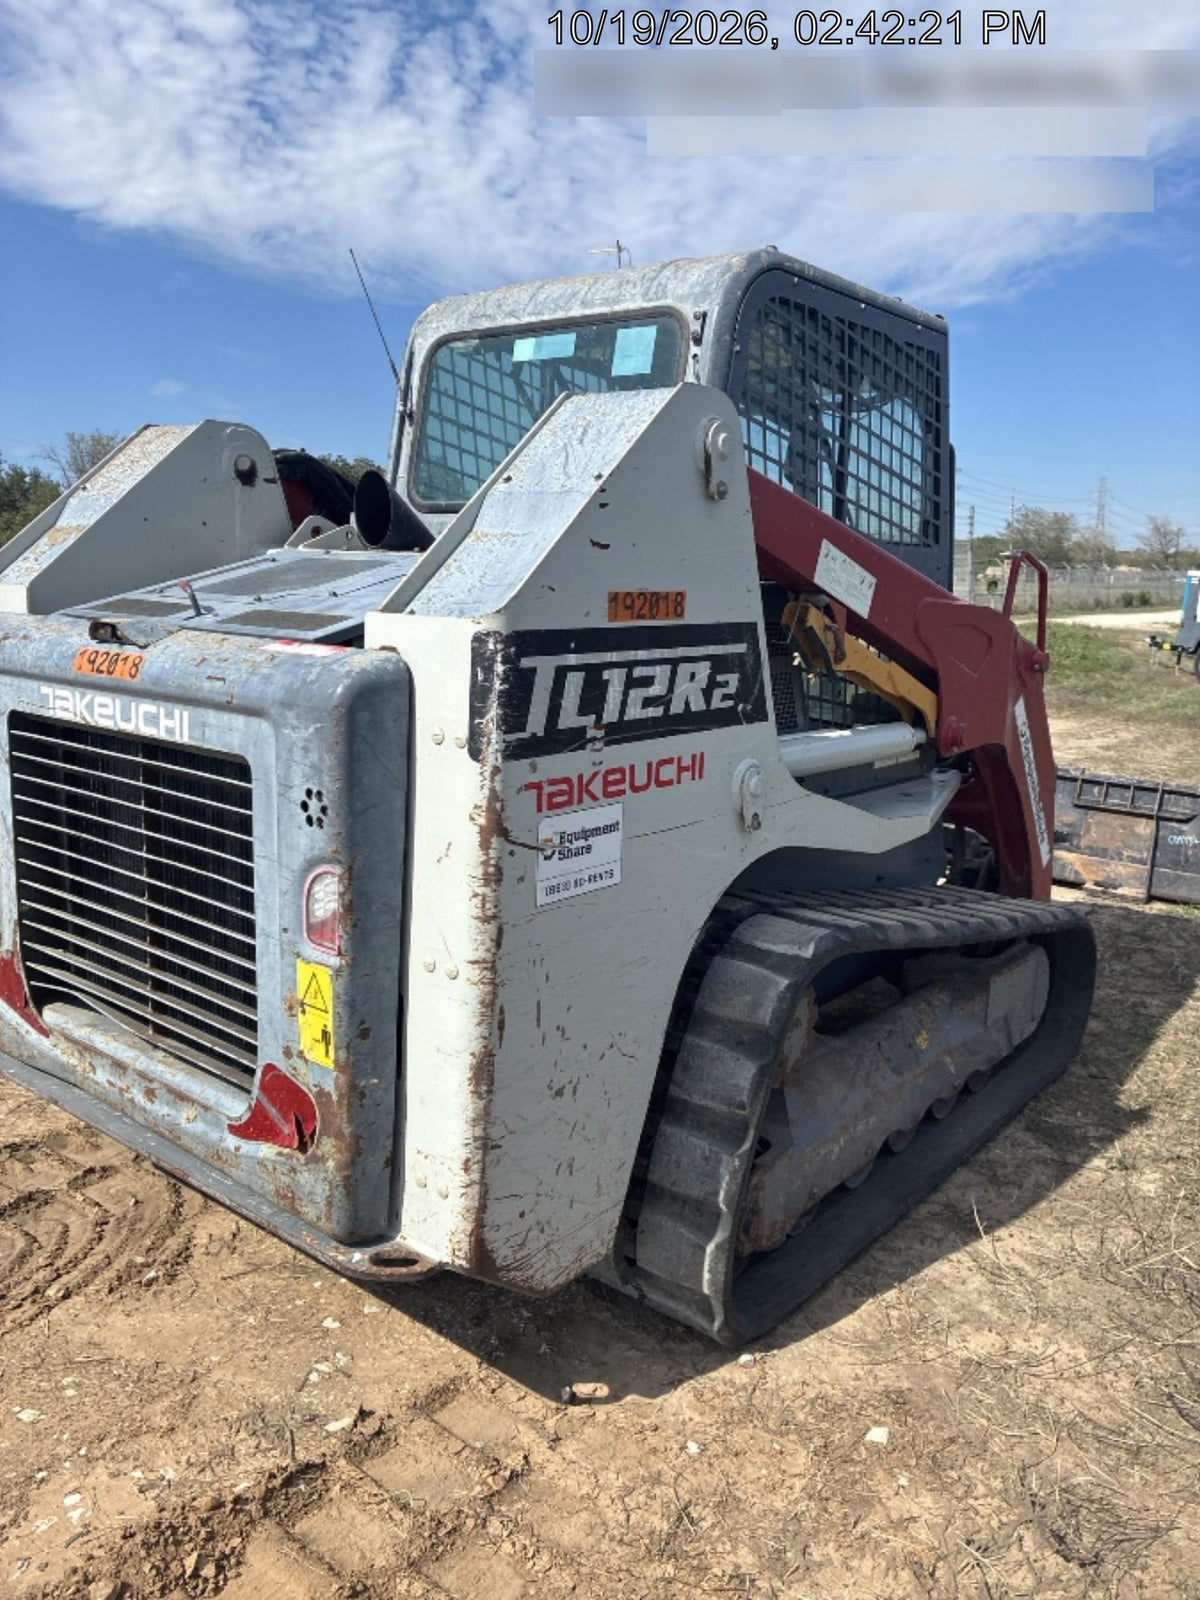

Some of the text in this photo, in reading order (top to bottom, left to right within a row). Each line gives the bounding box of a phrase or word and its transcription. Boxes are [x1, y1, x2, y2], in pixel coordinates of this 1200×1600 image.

[608, 591, 685, 619] 192018
[78, 649, 143, 679] 192018
[40, 686, 190, 741] TAKEUCHI
[524, 752, 705, 813] TAKEUCHI
[559, 820, 620, 845] Equipment
[558, 844, 593, 861] Share
